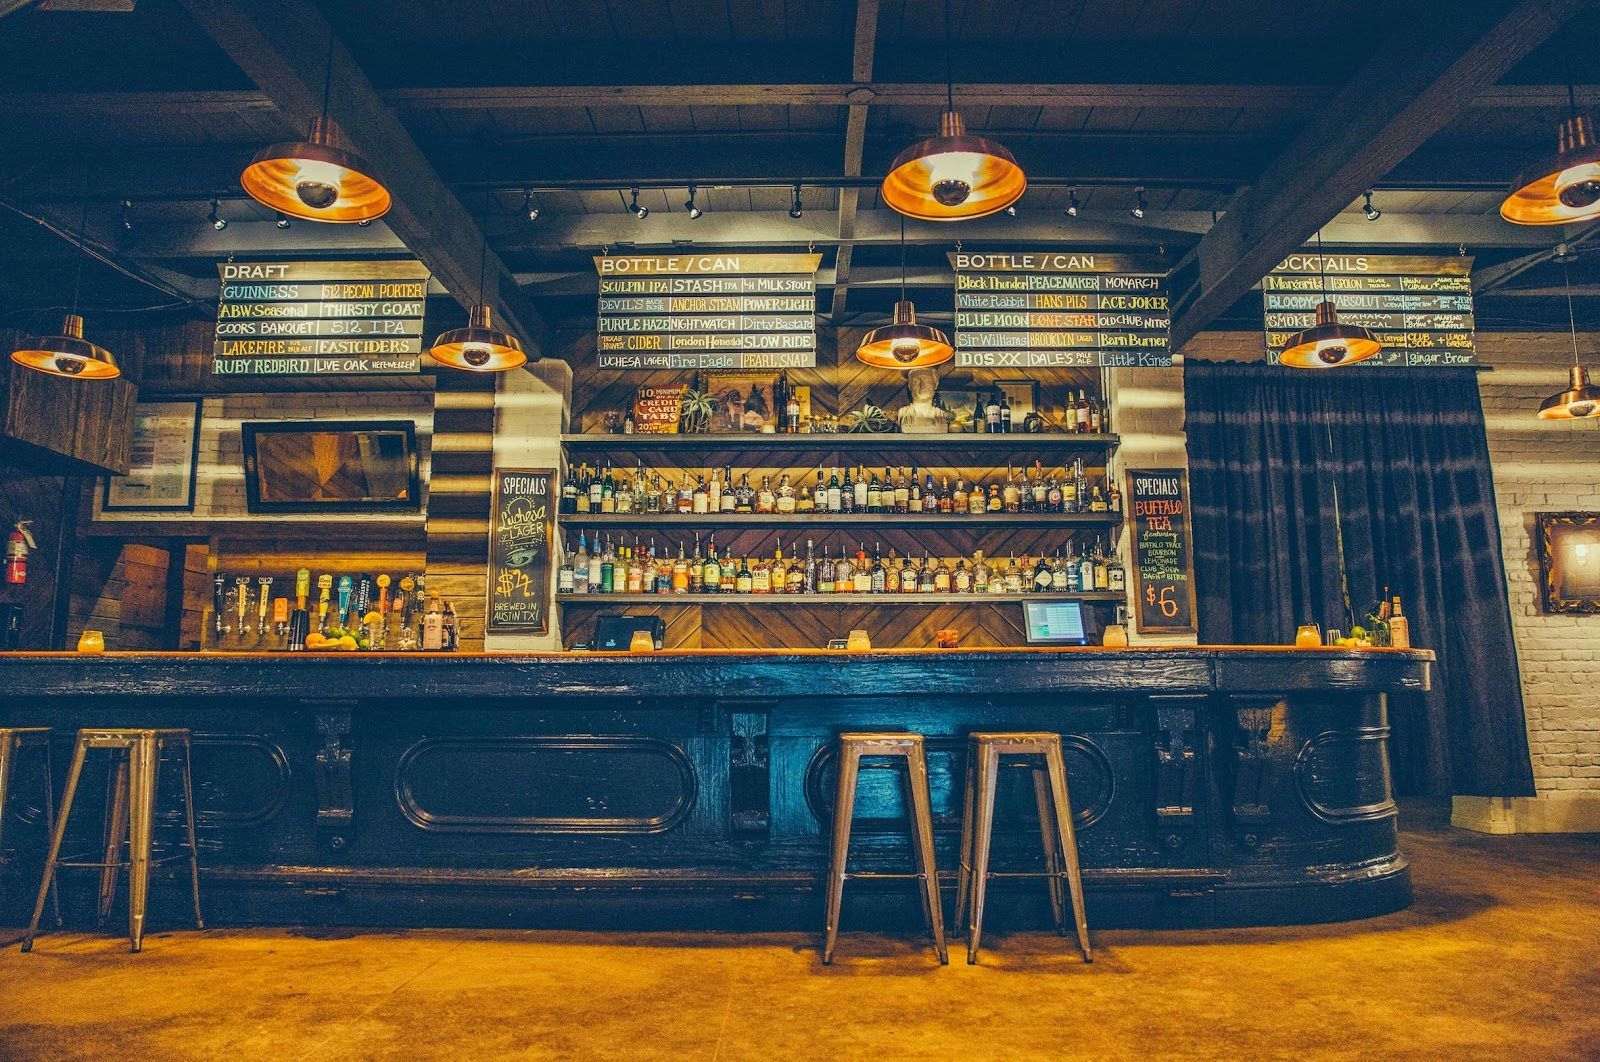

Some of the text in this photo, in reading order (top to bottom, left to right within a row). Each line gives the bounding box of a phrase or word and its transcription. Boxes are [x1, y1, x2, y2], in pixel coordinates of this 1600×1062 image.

[601, 258, 680, 272] BOTTLE
[698, 257, 740, 270] CAN
[956, 255, 1035, 268] BOTTLE
[1053, 256, 1094, 268] CAN
[1277, 256, 1368, 270] OCKTAILS
[224, 265, 290, 279] DRAFT
[601, 281, 669, 292] SCULPIN IPA
[673, 280, 738, 292] STASH IPA
[758, 278, 784, 291] MILK
[785, 279, 812, 291] STOUT
[958, 276, 1026, 290] Black Thunder
[1030, 276, 1098, 289] PEACEMAKER
[1105, 278, 1158, 289] MONARCH
[223, 284, 298, 299] GUINNESS
[323, 284, 424, 298] 512 PECAN PORTER
[672, 299, 741, 312] ANCHOR STEAM
[744, 298, 816, 312] POWER LIGHT
[958, 295, 1025, 308] White Rabbit
[1036, 296, 1088, 308] HANS PILS
[1100, 296, 1168, 310] ACE JOKER
[1336, 296, 1379, 309] ABSOLUT
[220, 304, 308, 318] ABW Seasonal
[324, 302, 420, 317] THIRSTY GOAT
[331, 320, 406, 334] 512 IPA
[600, 318, 670, 331] PURPLE HAZE
[744, 316, 814, 330] Dirty Bastard
[958, 314, 1028, 327] BLUE MOON
[1030, 314, 1098, 326] LONE STAR
[1100, 314, 1170, 328] OLD CHUB NITRO
[216, 321, 314, 334] COORS BANQUET
[628, 336, 662, 350] CIDER
[672, 335, 705, 349] London
[743, 336, 811, 348] SLOW RIDE
[958, 333, 1027, 347] Sir Williams
[1030, 334, 1075, 346] BROOKLYN
[1100, 333, 1168, 347] Barn Burner
[1407, 333, 1430, 341] CLUB
[222, 340, 285, 356] LAKEFIRE
[320, 340, 409, 354] EASTCIDERS
[317, 360, 340, 372] LIVE
[343, 359, 369, 371] OAK
[600, 356, 669, 367] LUCHESA LAGER
[671, 354, 734, 368] Fire Eagle
[744, 354, 808, 366] PEARL SNAP
[961, 352, 1021, 366] DOS XX
[1031, 352, 1073, 365] DALE'S
[1101, 352, 1172, 366] Little Kings
[1409, 352, 1441, 366] ginger
[215, 359, 309, 374] RUBY REDBIRD
[639, 411, 676, 422] TABS
[504, 477, 546, 495] SPECIALS
[1136, 478, 1178, 496] SPECIALS
[1136, 500, 1183, 516] BUFFALO
[509, 522, 544, 539] LAGER
[1146, 516, 1172, 531] TEA
[494, 602, 537, 611] BREWED IN
[1146, 584, 1178, 617] $6
[494, 611, 520, 621] AUSTIN
